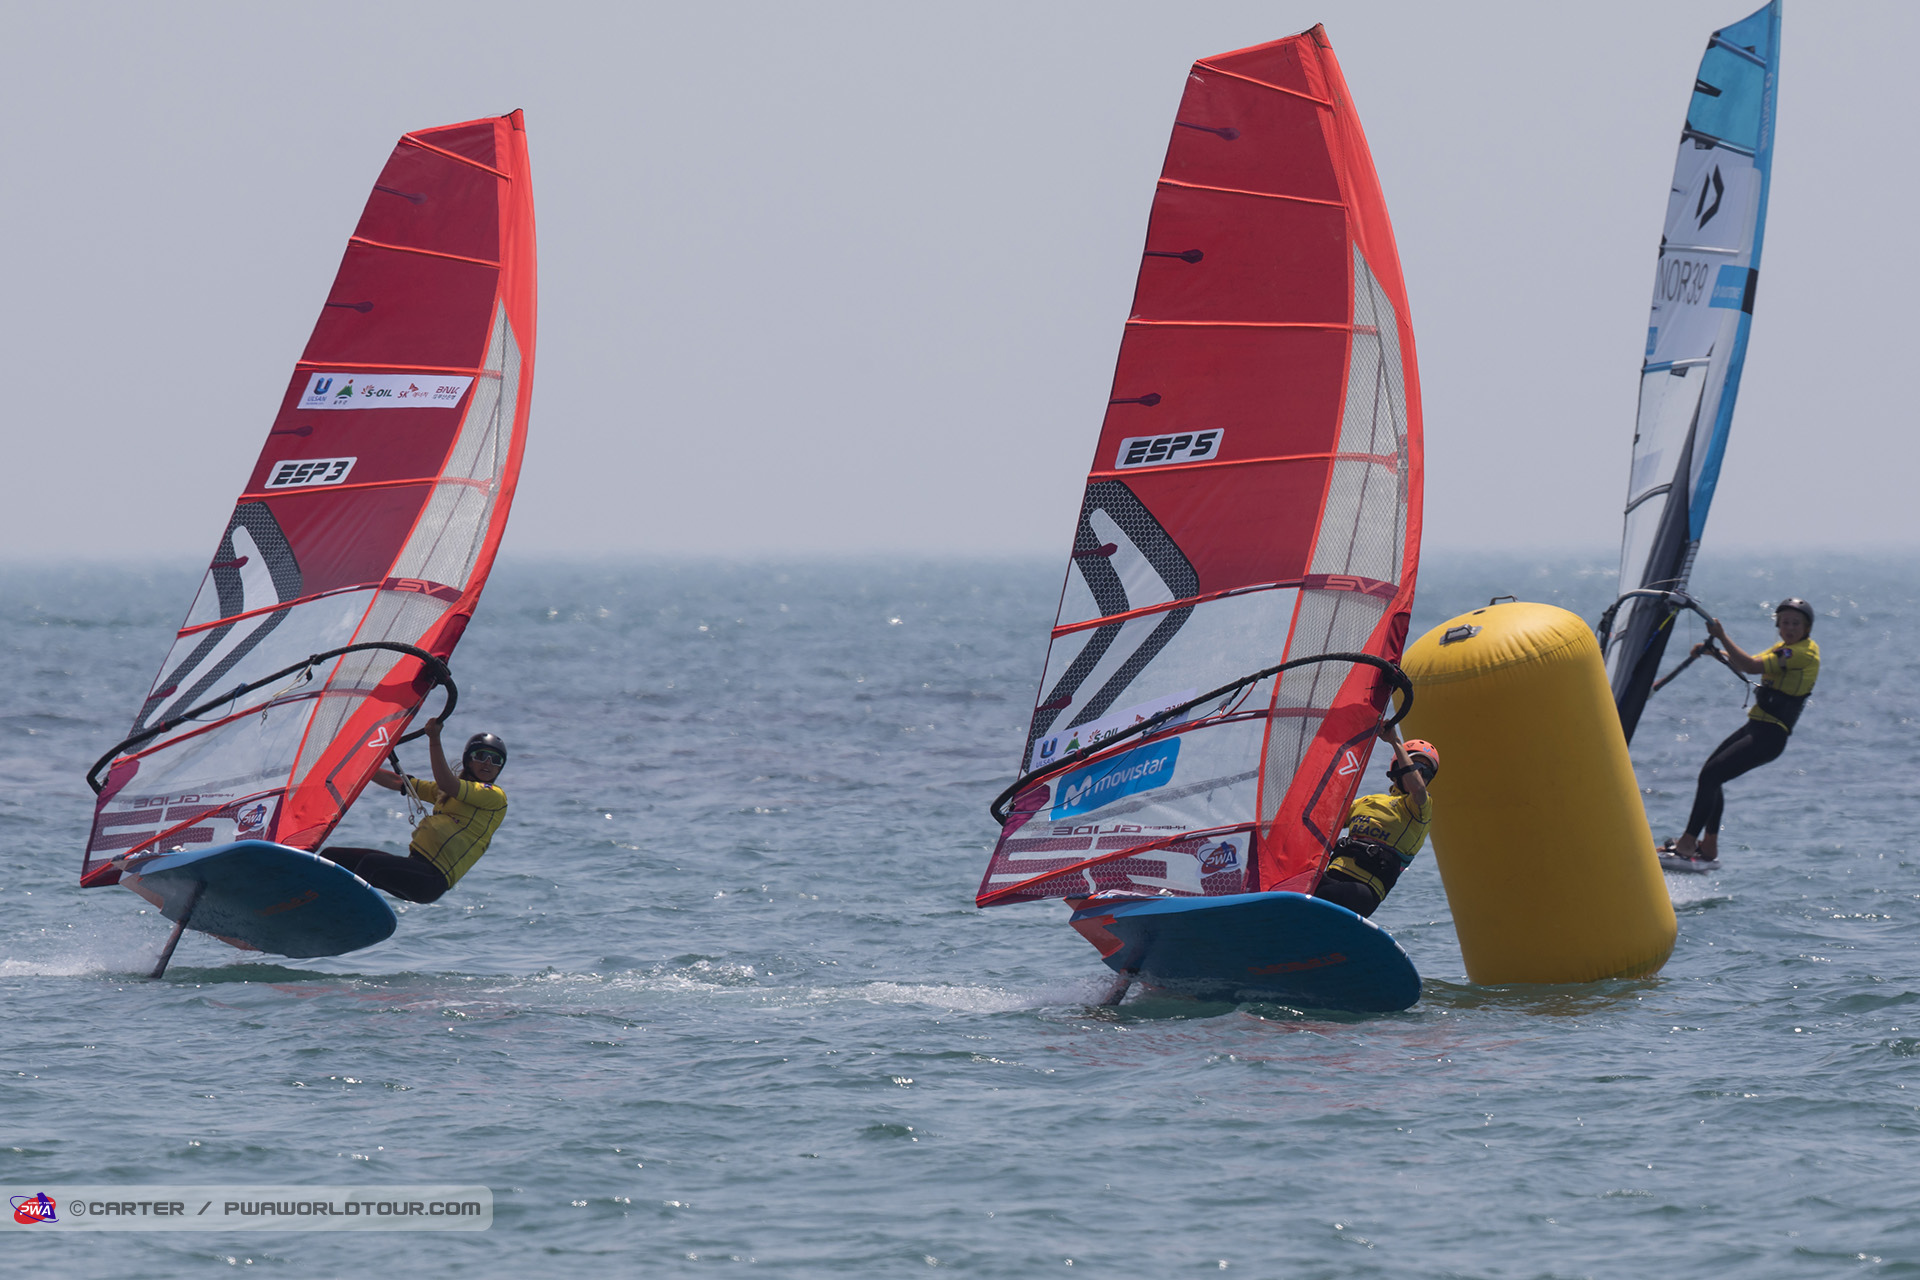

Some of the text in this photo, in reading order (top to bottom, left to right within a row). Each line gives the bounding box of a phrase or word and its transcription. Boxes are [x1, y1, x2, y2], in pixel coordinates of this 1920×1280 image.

[1655, 258, 1709, 305] NOR39
[365, 388, 393, 398] S-OIL
[1094, 756, 1168, 794] movistar
[1351, 824, 1391, 841] BEACH
